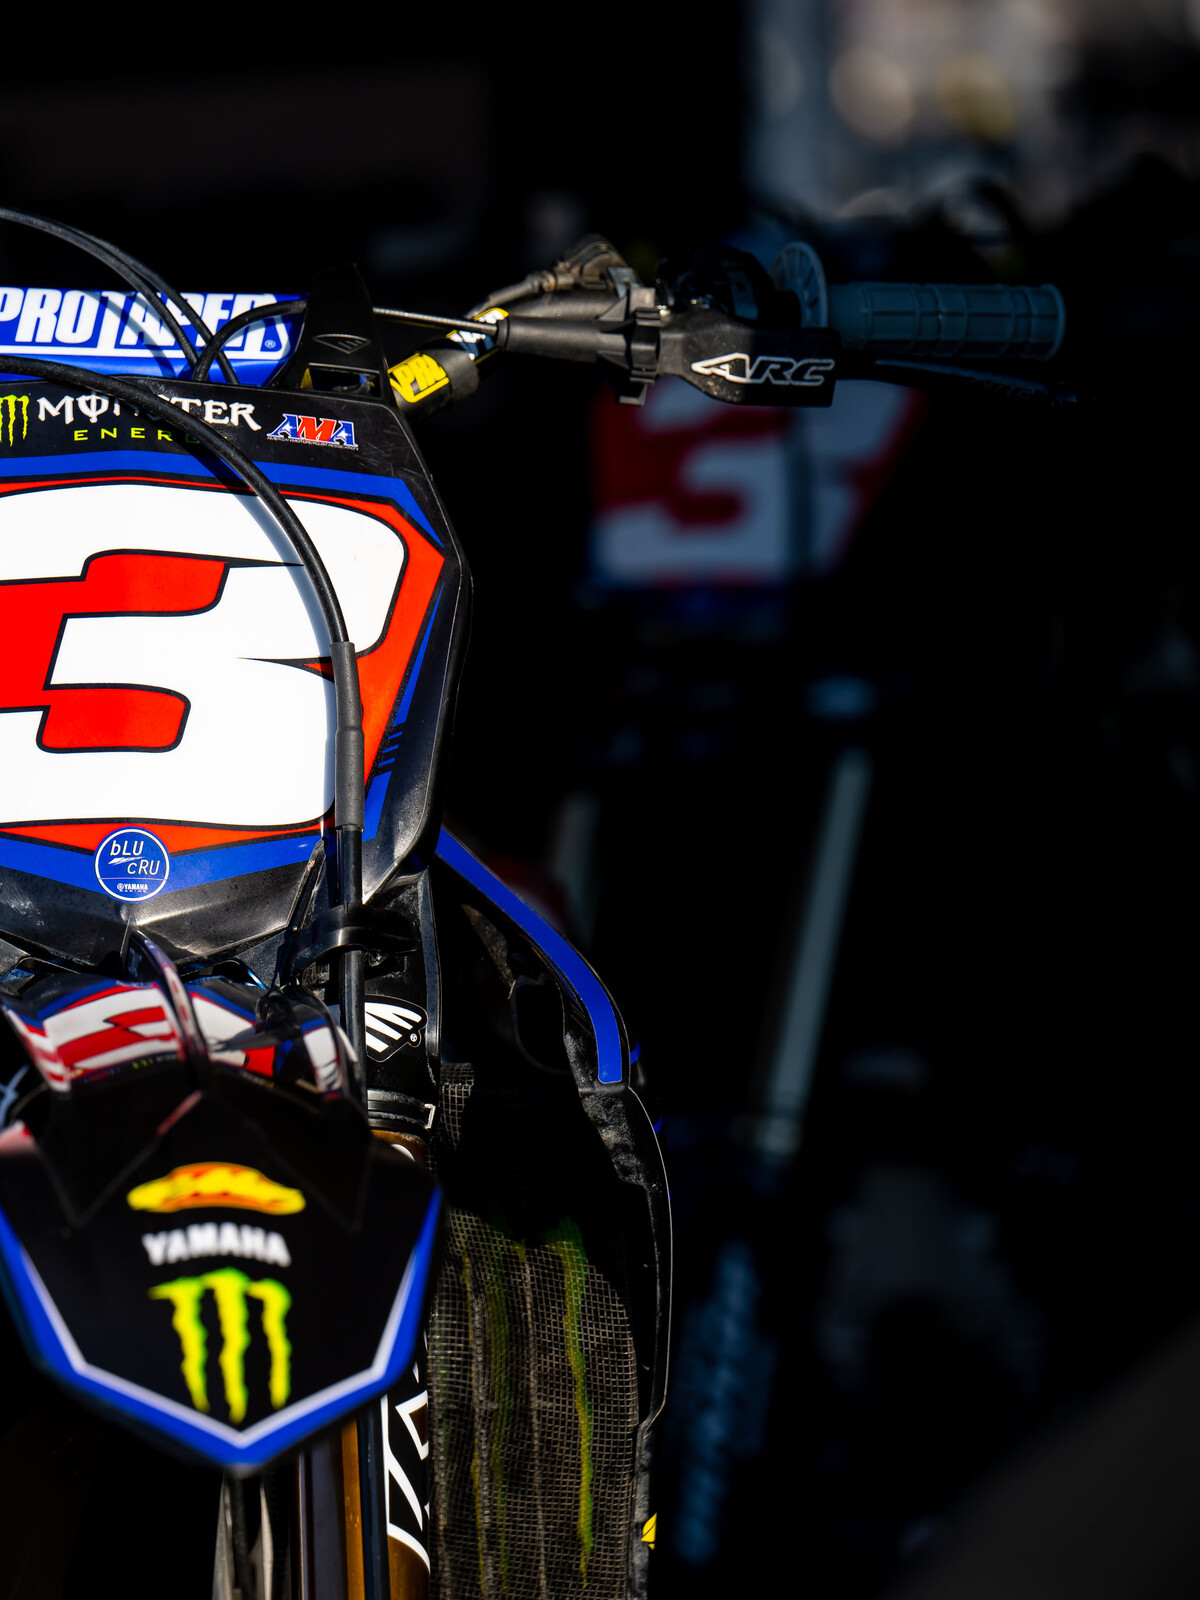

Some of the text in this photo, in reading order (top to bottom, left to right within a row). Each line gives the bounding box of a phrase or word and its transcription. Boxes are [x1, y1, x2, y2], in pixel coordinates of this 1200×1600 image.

[692, 353, 837, 387] ARC
[36, 389, 262, 432] MOTER
[267, 414, 358, 447] AMA
[109, 840, 144, 856] bLU
[127, 860, 160, 875] cRU
[124, 883, 149, 891] YAMAHA
[141, 1221, 292, 1267] YAMAHA
